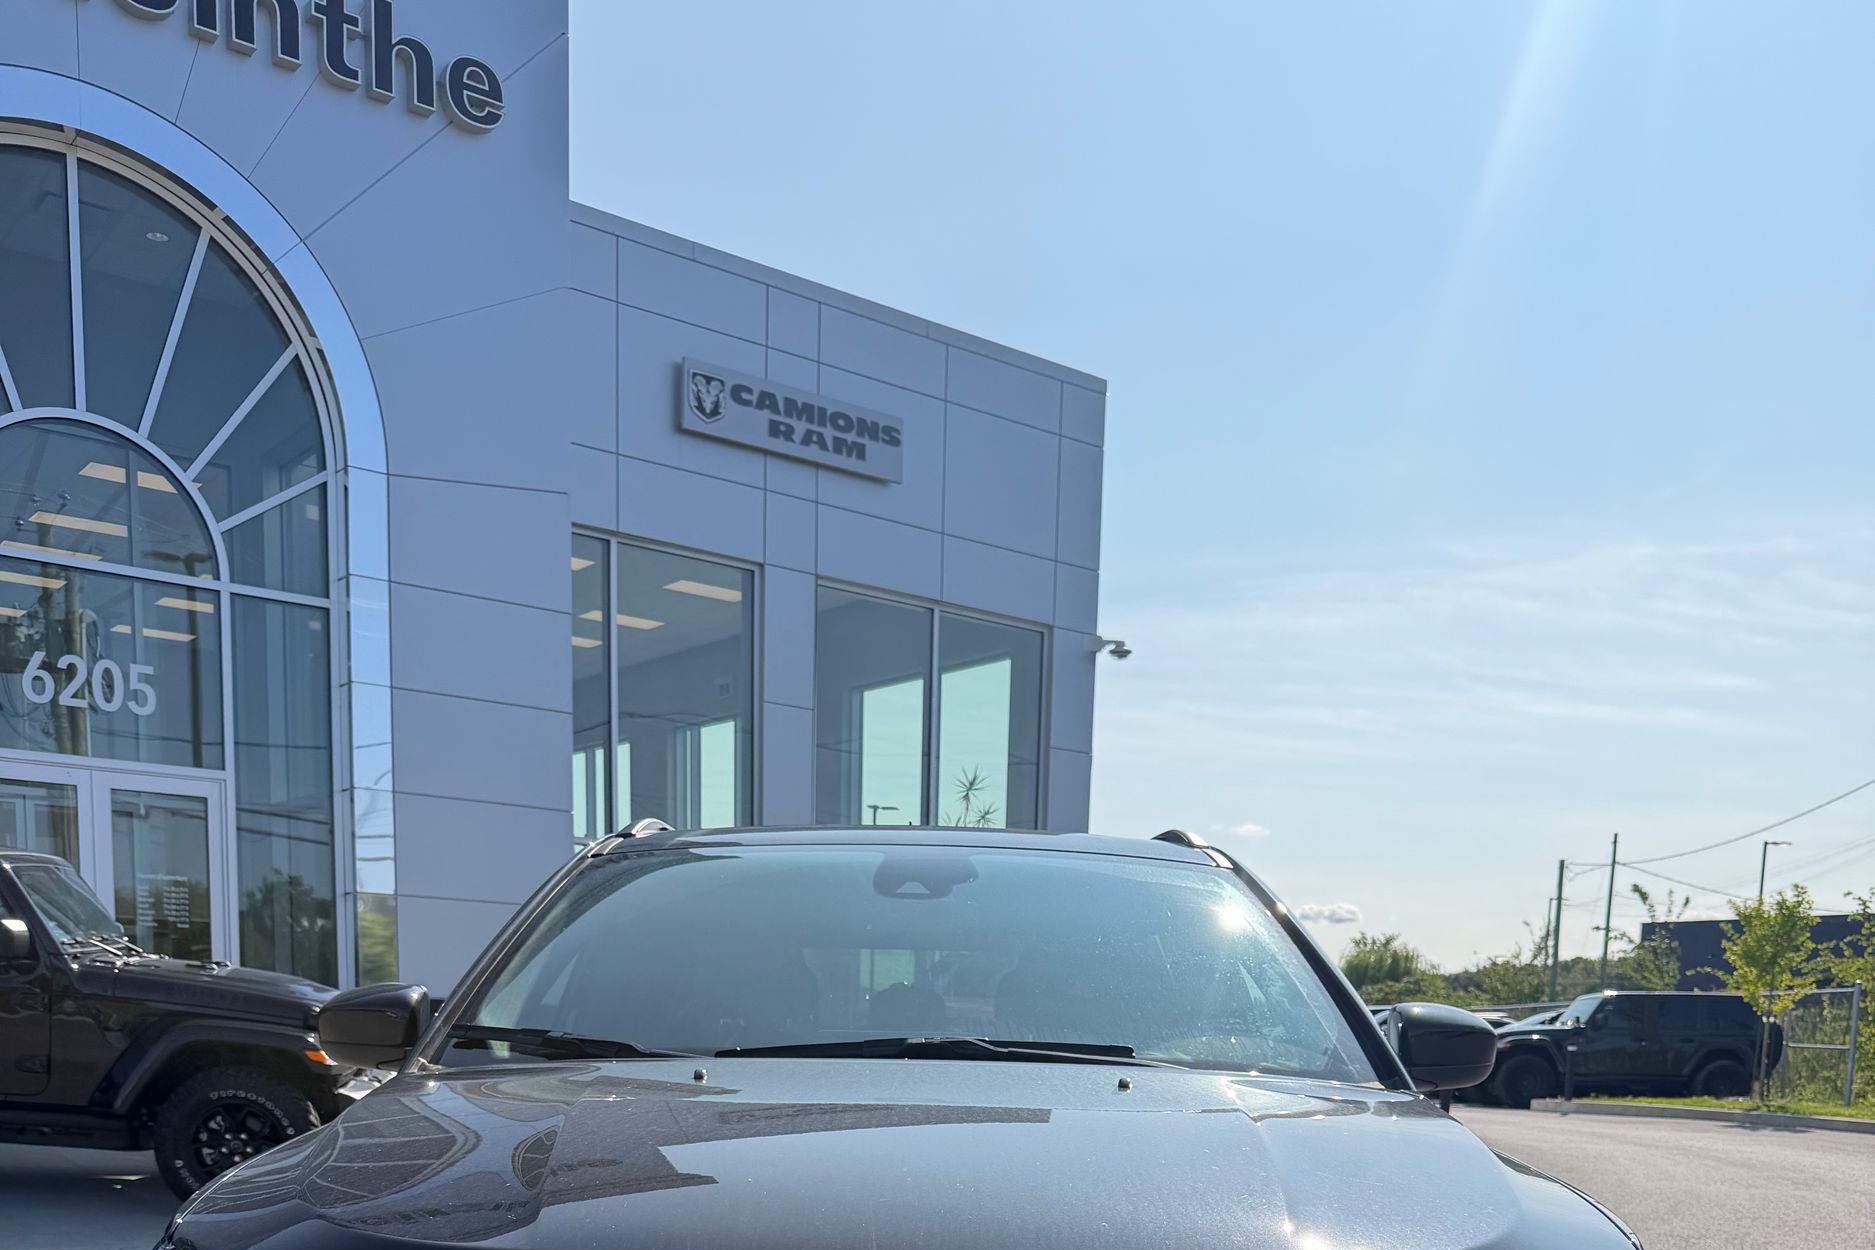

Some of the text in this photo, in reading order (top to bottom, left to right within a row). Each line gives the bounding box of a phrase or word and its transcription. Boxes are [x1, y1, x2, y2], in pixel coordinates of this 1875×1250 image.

[730, 383, 902, 448] CAMIONS
[767, 418, 867, 462] RAM
[22, 651, 157, 716] 6205
